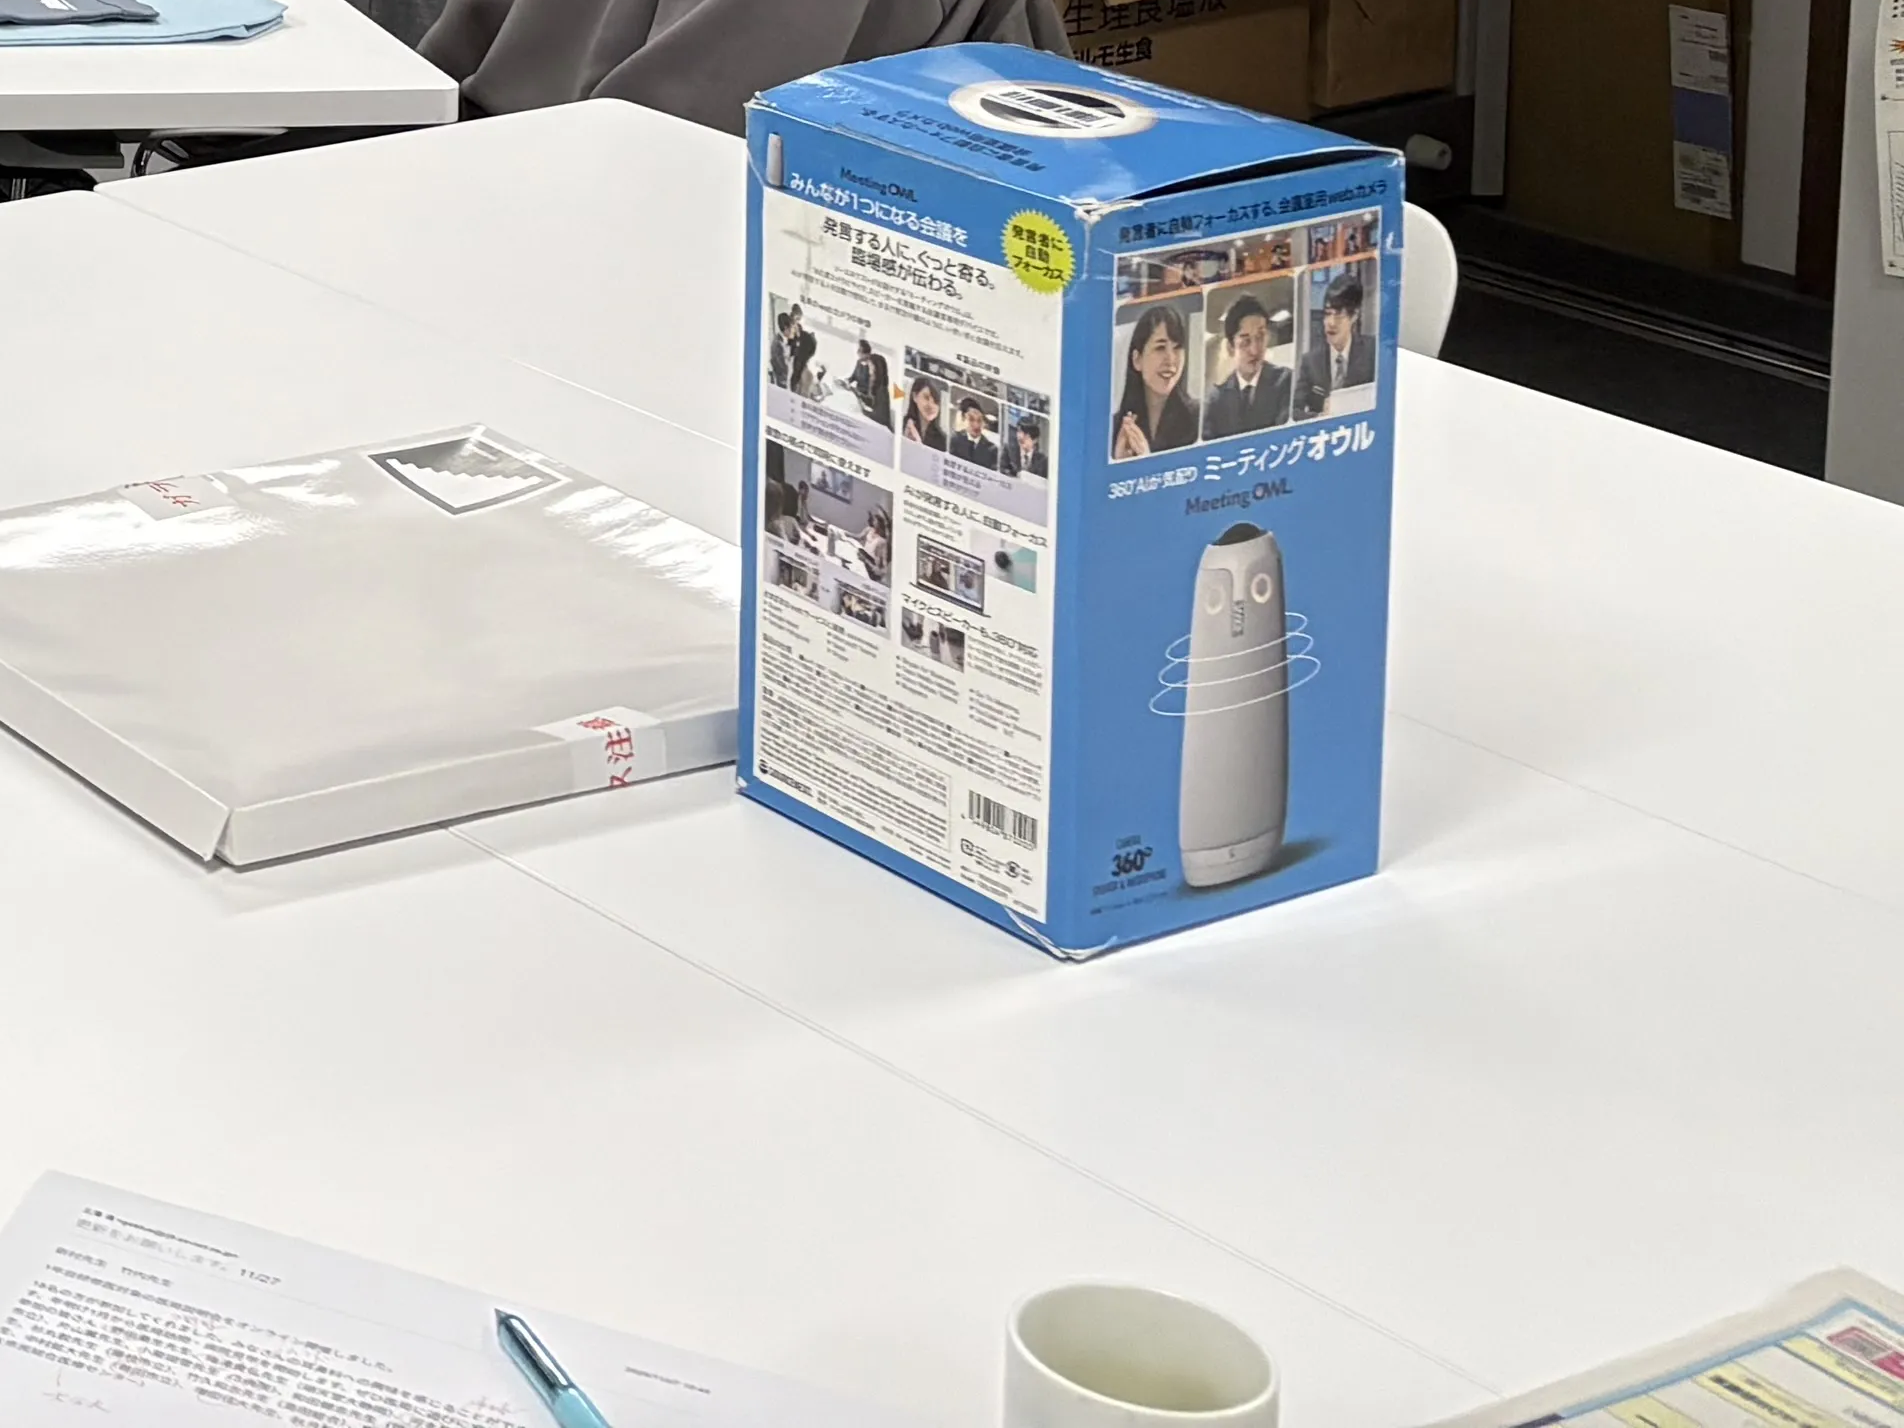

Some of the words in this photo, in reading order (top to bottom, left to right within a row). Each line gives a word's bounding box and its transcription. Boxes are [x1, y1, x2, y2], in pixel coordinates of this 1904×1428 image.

[1072, 36, 1153, 66] ルモ生食
[790, 172, 969, 248] みんなが1つになる会議を
[1011, 223, 1064, 252] 発言者に
[1011, 254, 1065, 282] フォーカス
[1024, 243, 1050, 263] 自動
[1203, 420, 1377, 482] ミーティングオウル
[1183, 486, 1251, 517] Meeting
[1251, 476, 1294, 502] OWL
